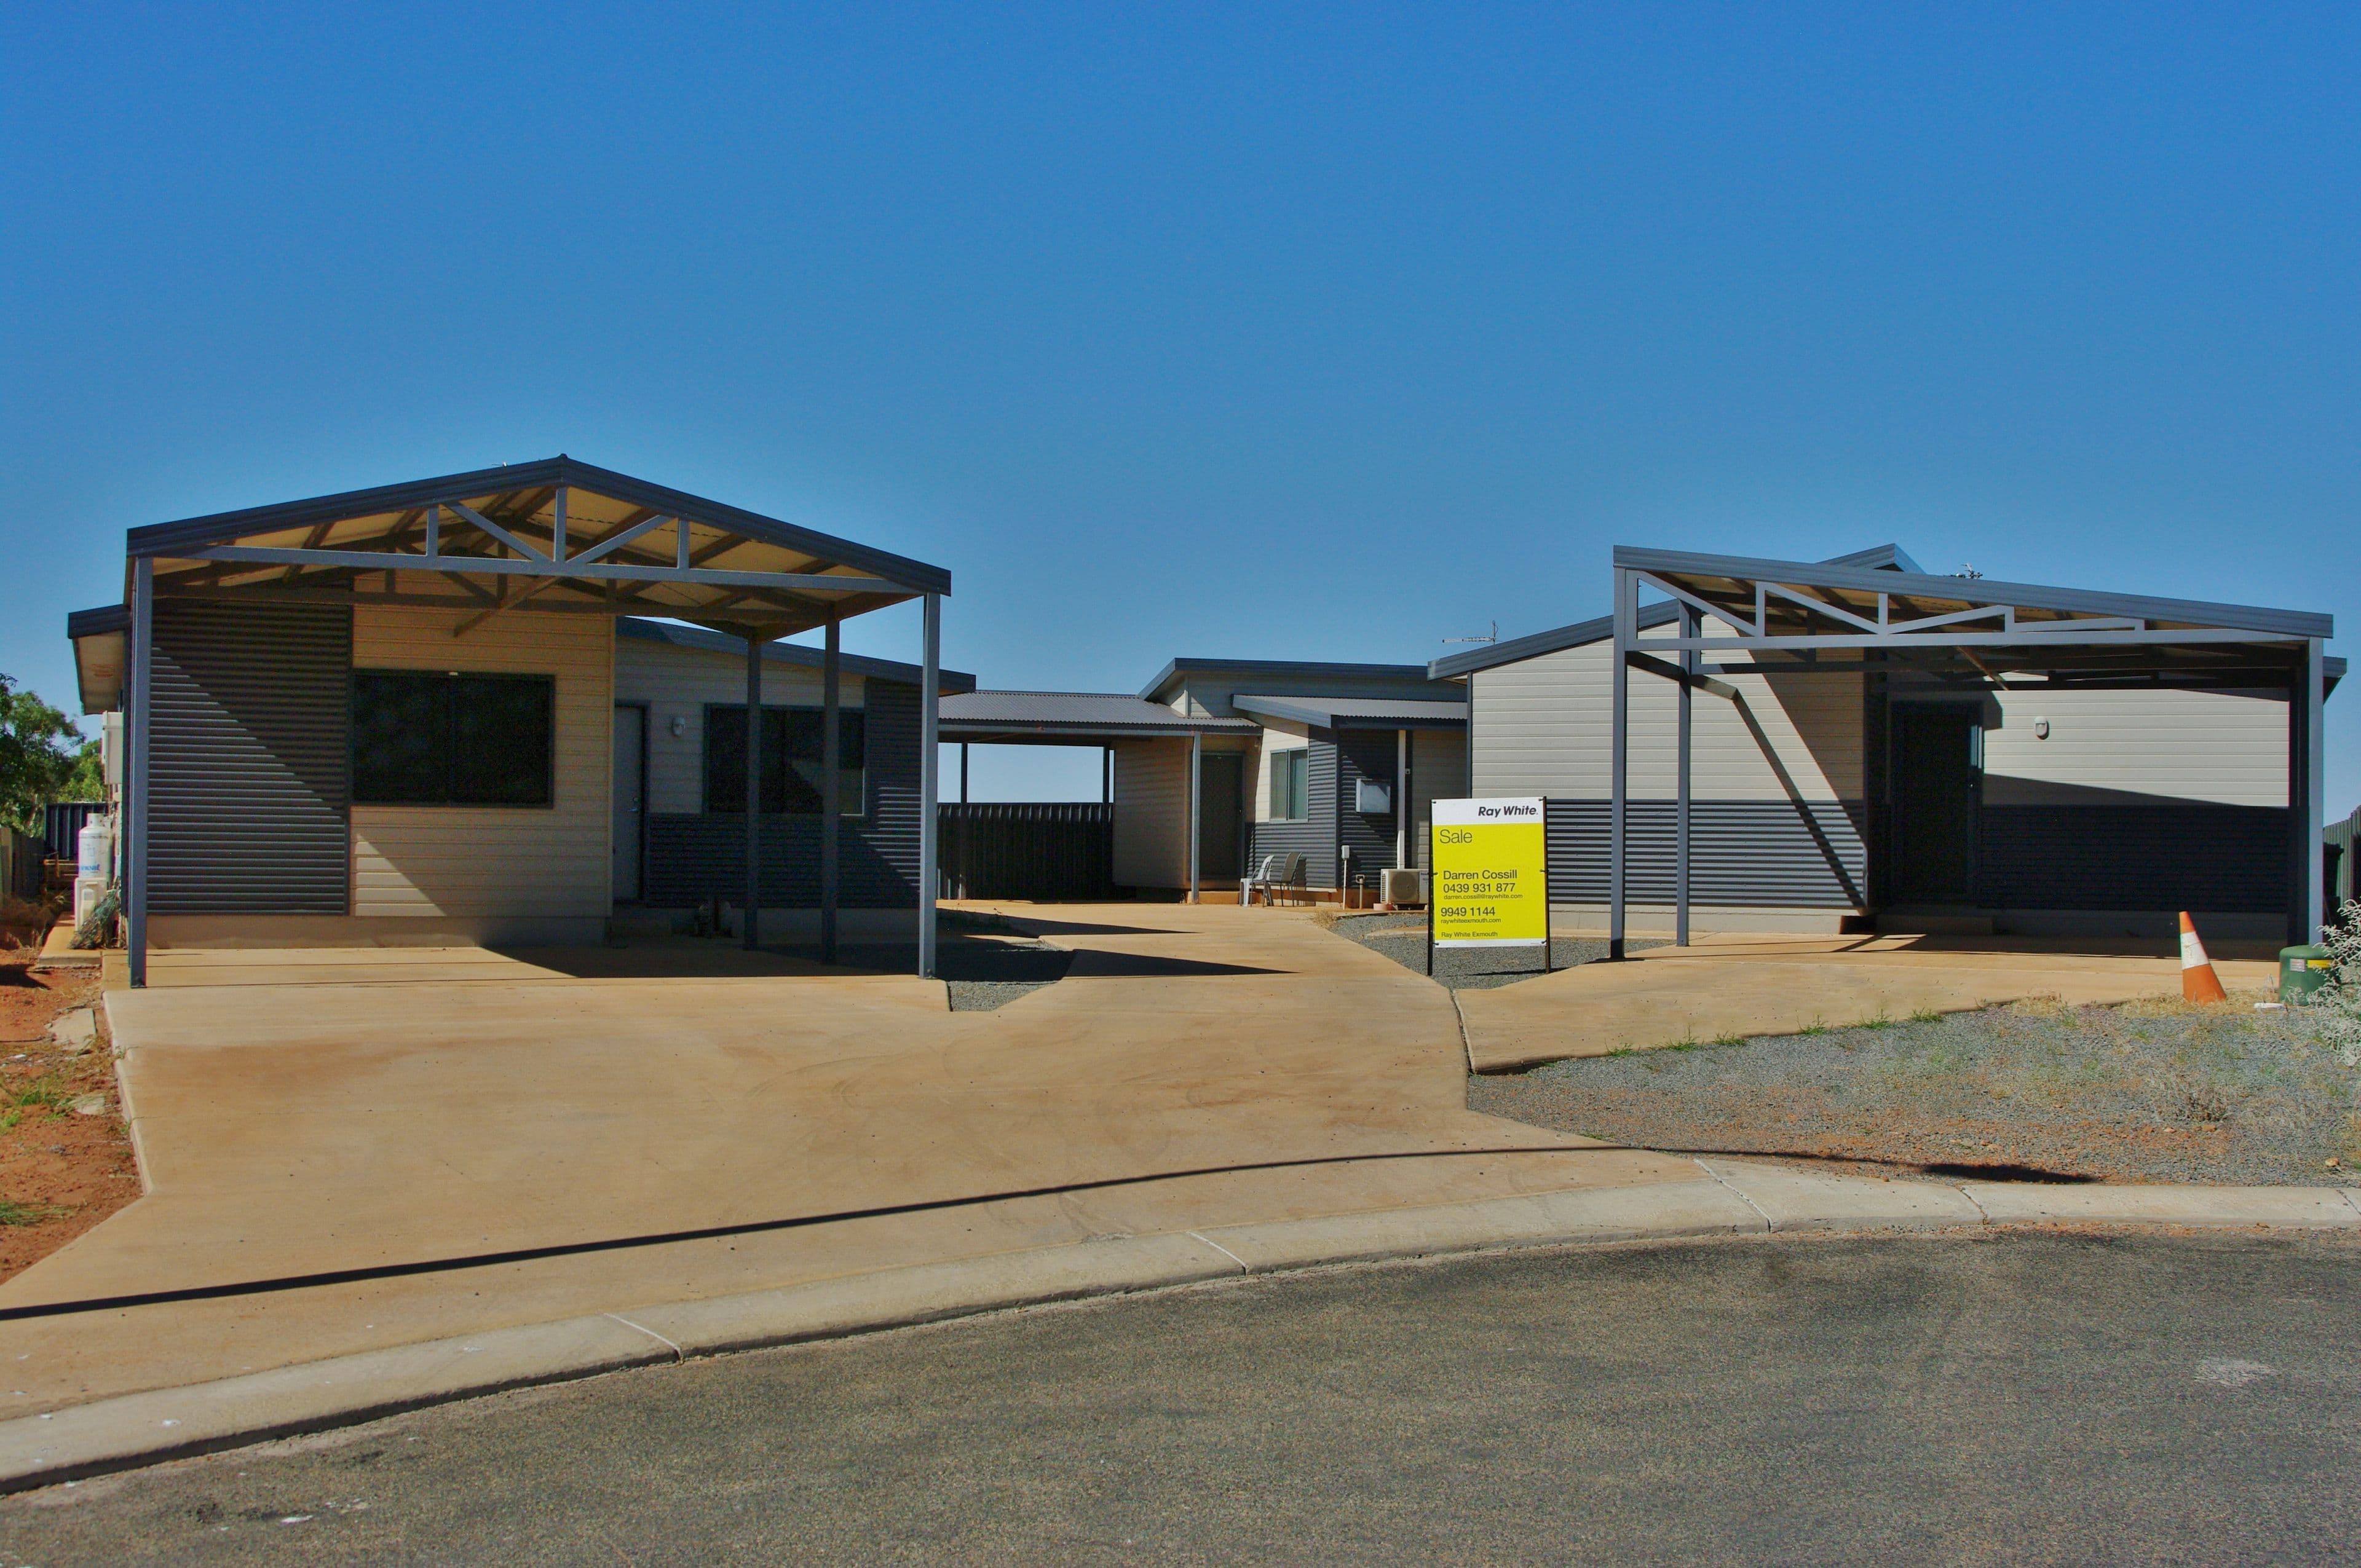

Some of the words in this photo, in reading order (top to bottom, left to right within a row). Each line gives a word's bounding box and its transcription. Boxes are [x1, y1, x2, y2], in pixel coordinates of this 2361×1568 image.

[1478, 806, 1501, 817] Ray
[1504, 806, 1536, 816] White
[1440, 829, 1473, 843] Sale
[1444, 870, 1478, 880] Darren
[1482, 869, 1517, 880] Cossill
[1443, 883, 1469, 893] 0439
[1473, 883, 1491, 892] 931
[1496, 883, 1516, 892] 877
[1441, 907, 1466, 916] 9949
[1470, 907, 1495, 916] 1144
